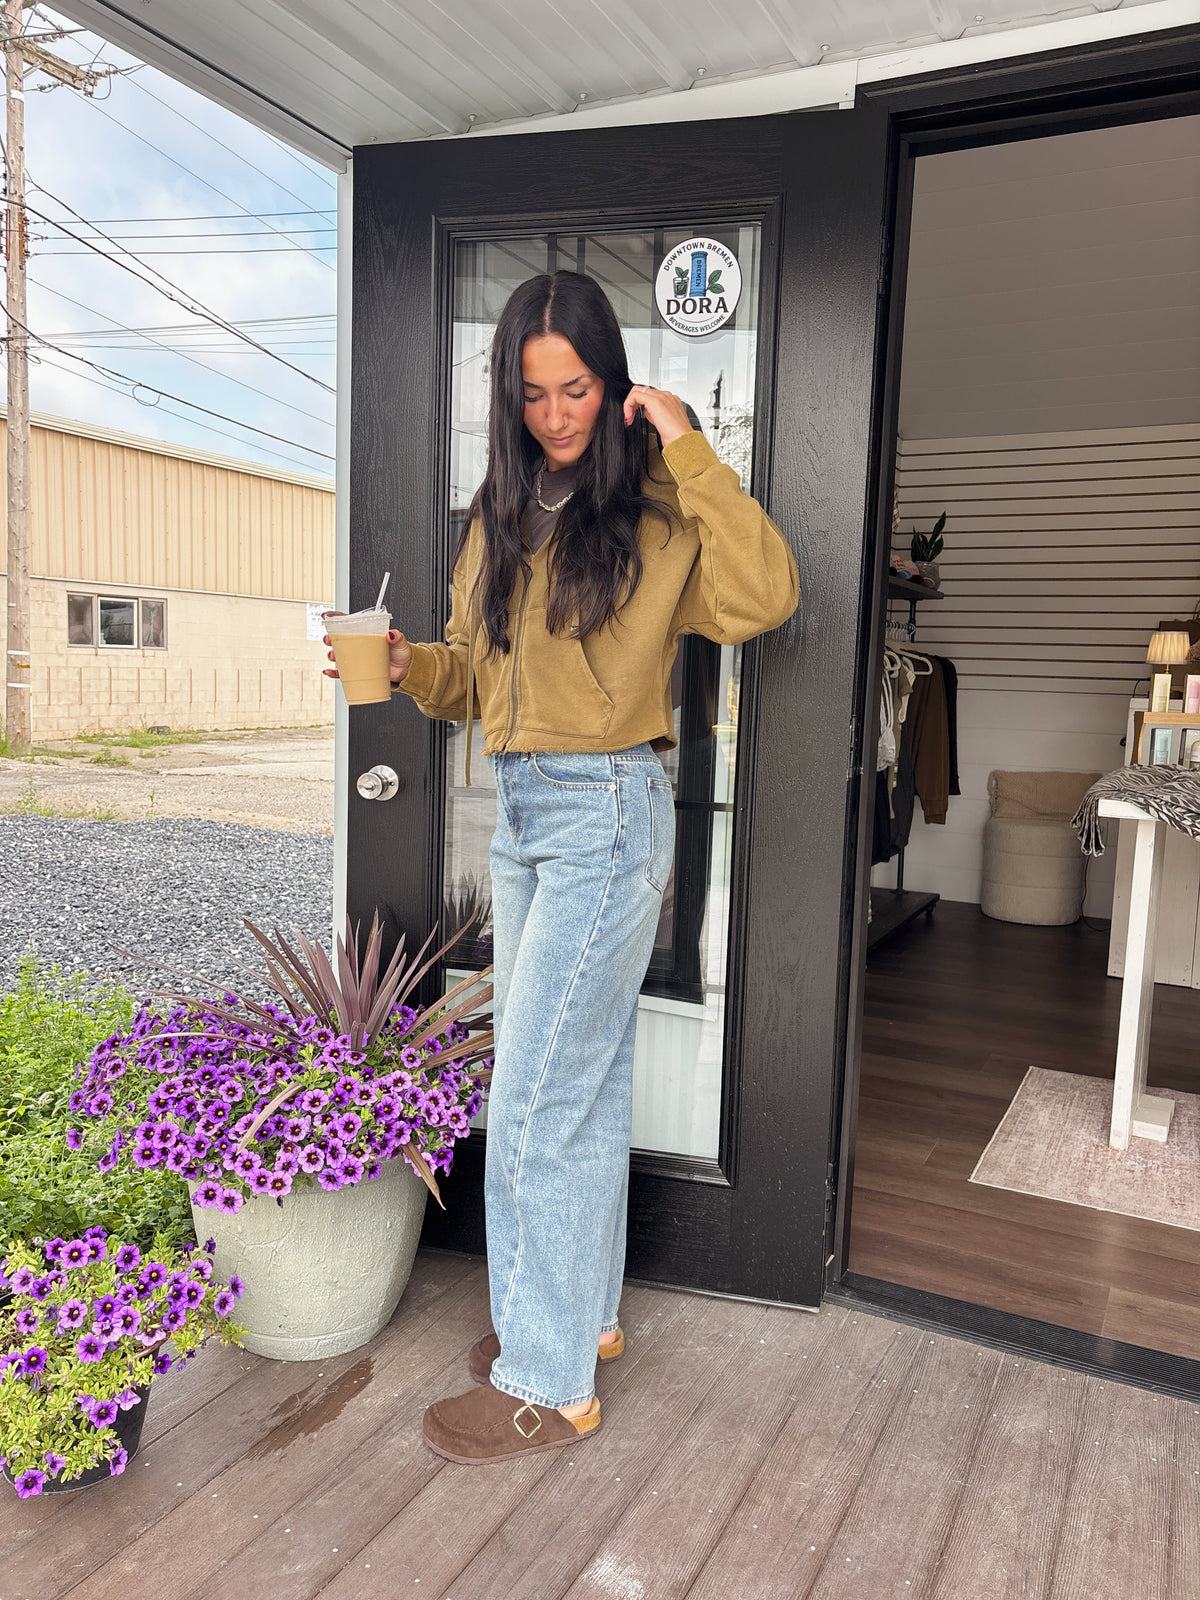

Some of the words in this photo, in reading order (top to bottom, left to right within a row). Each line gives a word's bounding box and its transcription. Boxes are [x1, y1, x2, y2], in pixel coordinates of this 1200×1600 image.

[664, 242, 705, 271] DOWNTOWN
[707, 243, 734, 268] BREMEN
[666, 297, 729, 315] DORA
[668, 316, 699, 333] BEVERAGES
[699, 314, 726, 332] WELCOME
